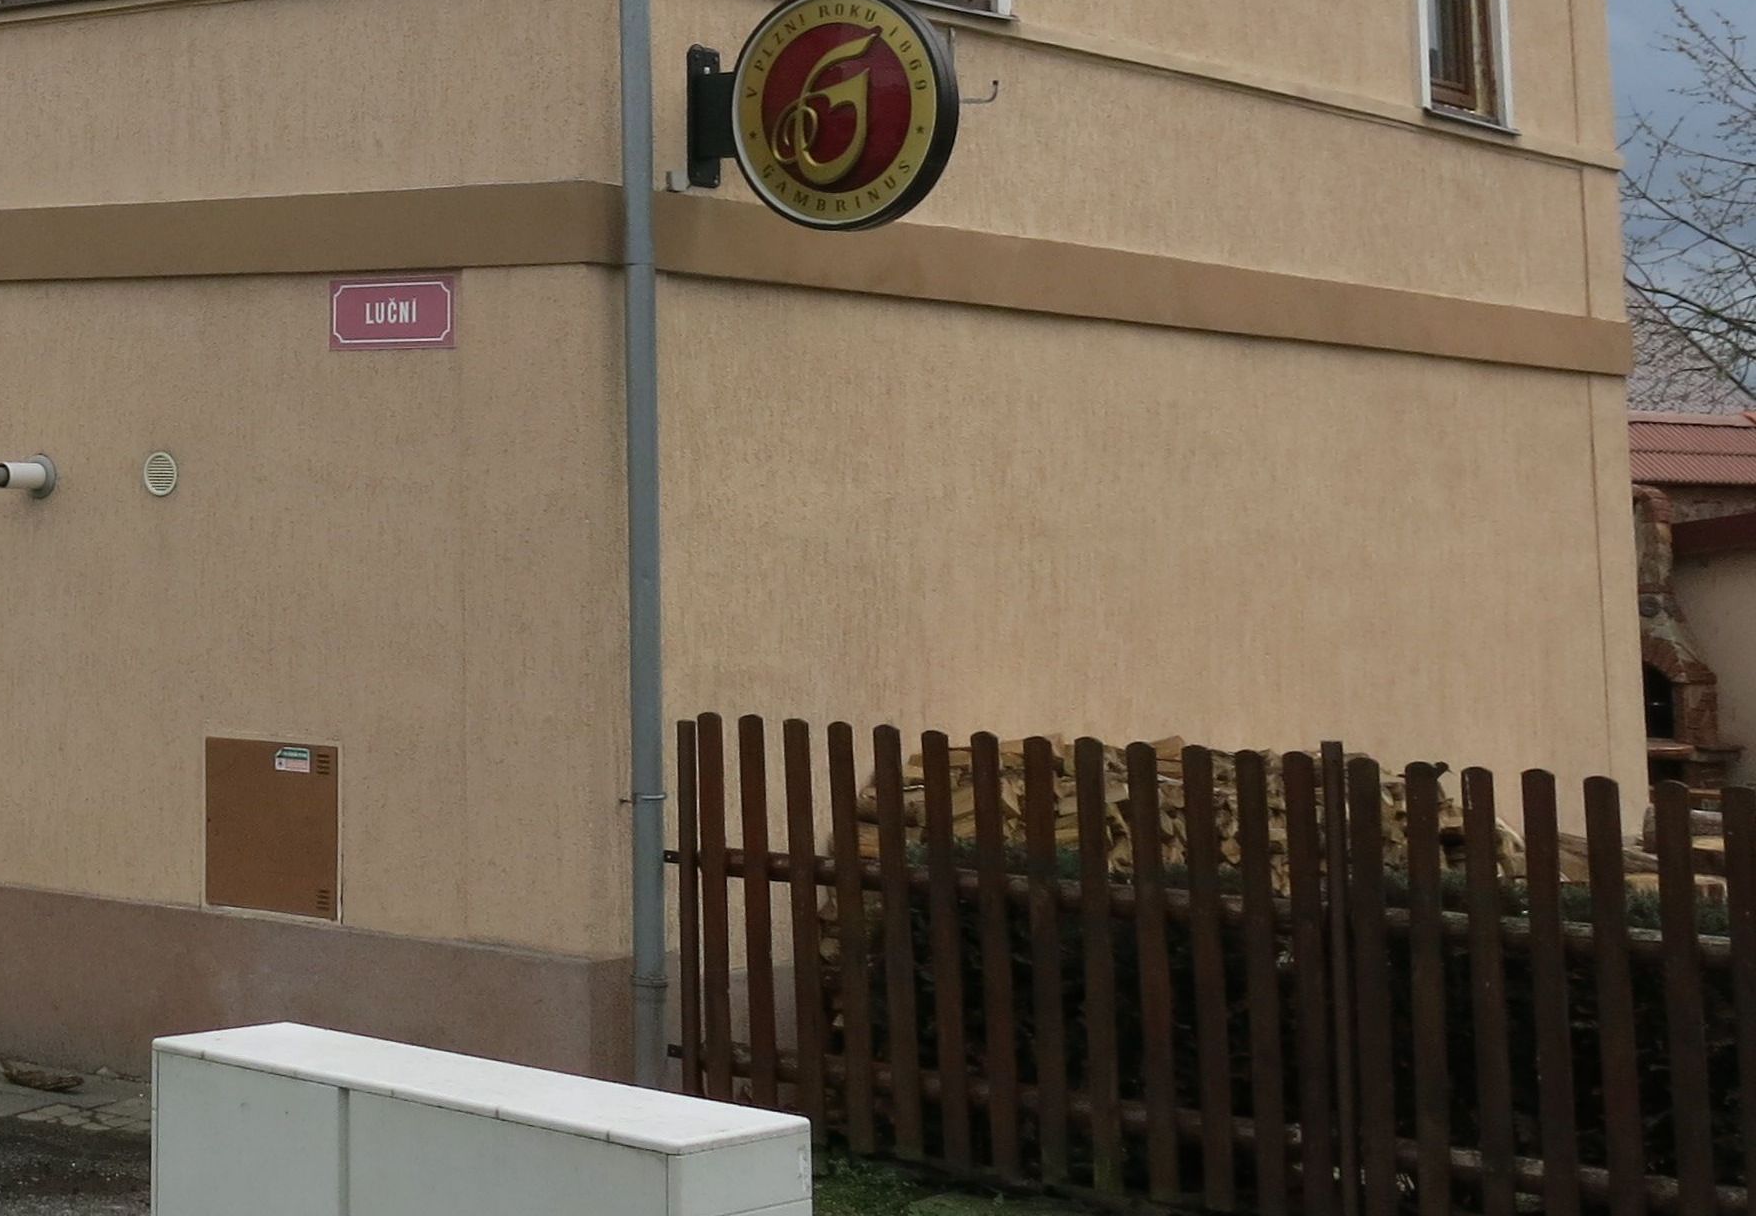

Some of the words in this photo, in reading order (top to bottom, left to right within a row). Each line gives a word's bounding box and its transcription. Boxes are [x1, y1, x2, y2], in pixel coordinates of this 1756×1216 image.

[746, 87, 758, 99] V
[754, 13, 805, 72] PLZNI
[818, 3, 877, 23] ROKU
[762, 160, 911, 213] GAMBRINUS
[365, 297, 417, 324] LUČNÍ
